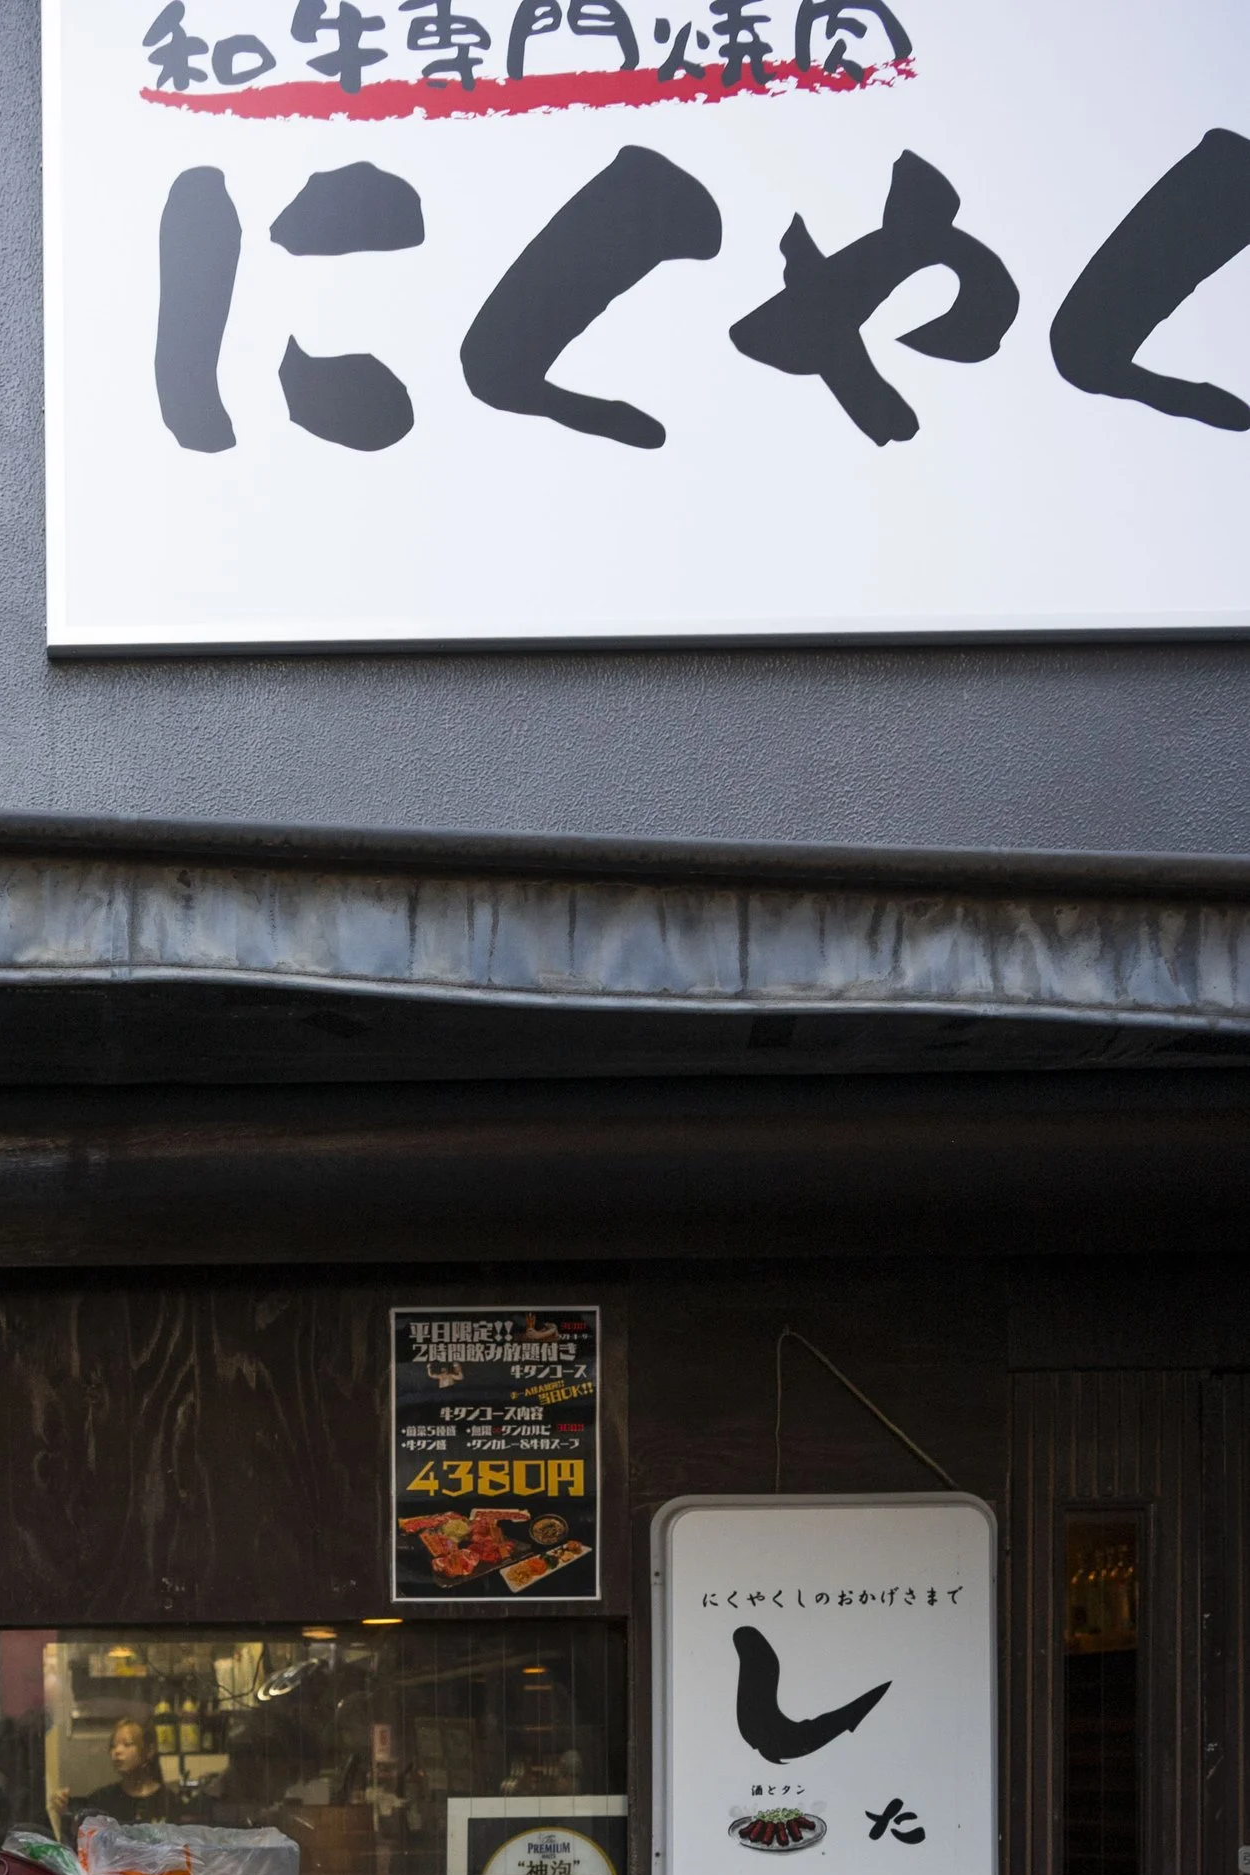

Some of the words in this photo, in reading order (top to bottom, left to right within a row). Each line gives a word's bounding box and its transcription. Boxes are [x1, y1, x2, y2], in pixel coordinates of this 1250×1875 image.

[510, 1364, 588, 1380] 牛タンコース
[440, 1406, 545, 1422] 牛タンコース内容
[406, 1459, 585, 1498] 4380円
[702, 1585, 965, 1609] にくやくしのおかげさまで
[750, 1784, 807, 1797] 酒とタン
[527, 1842, 571, 1854] PREMIUM
